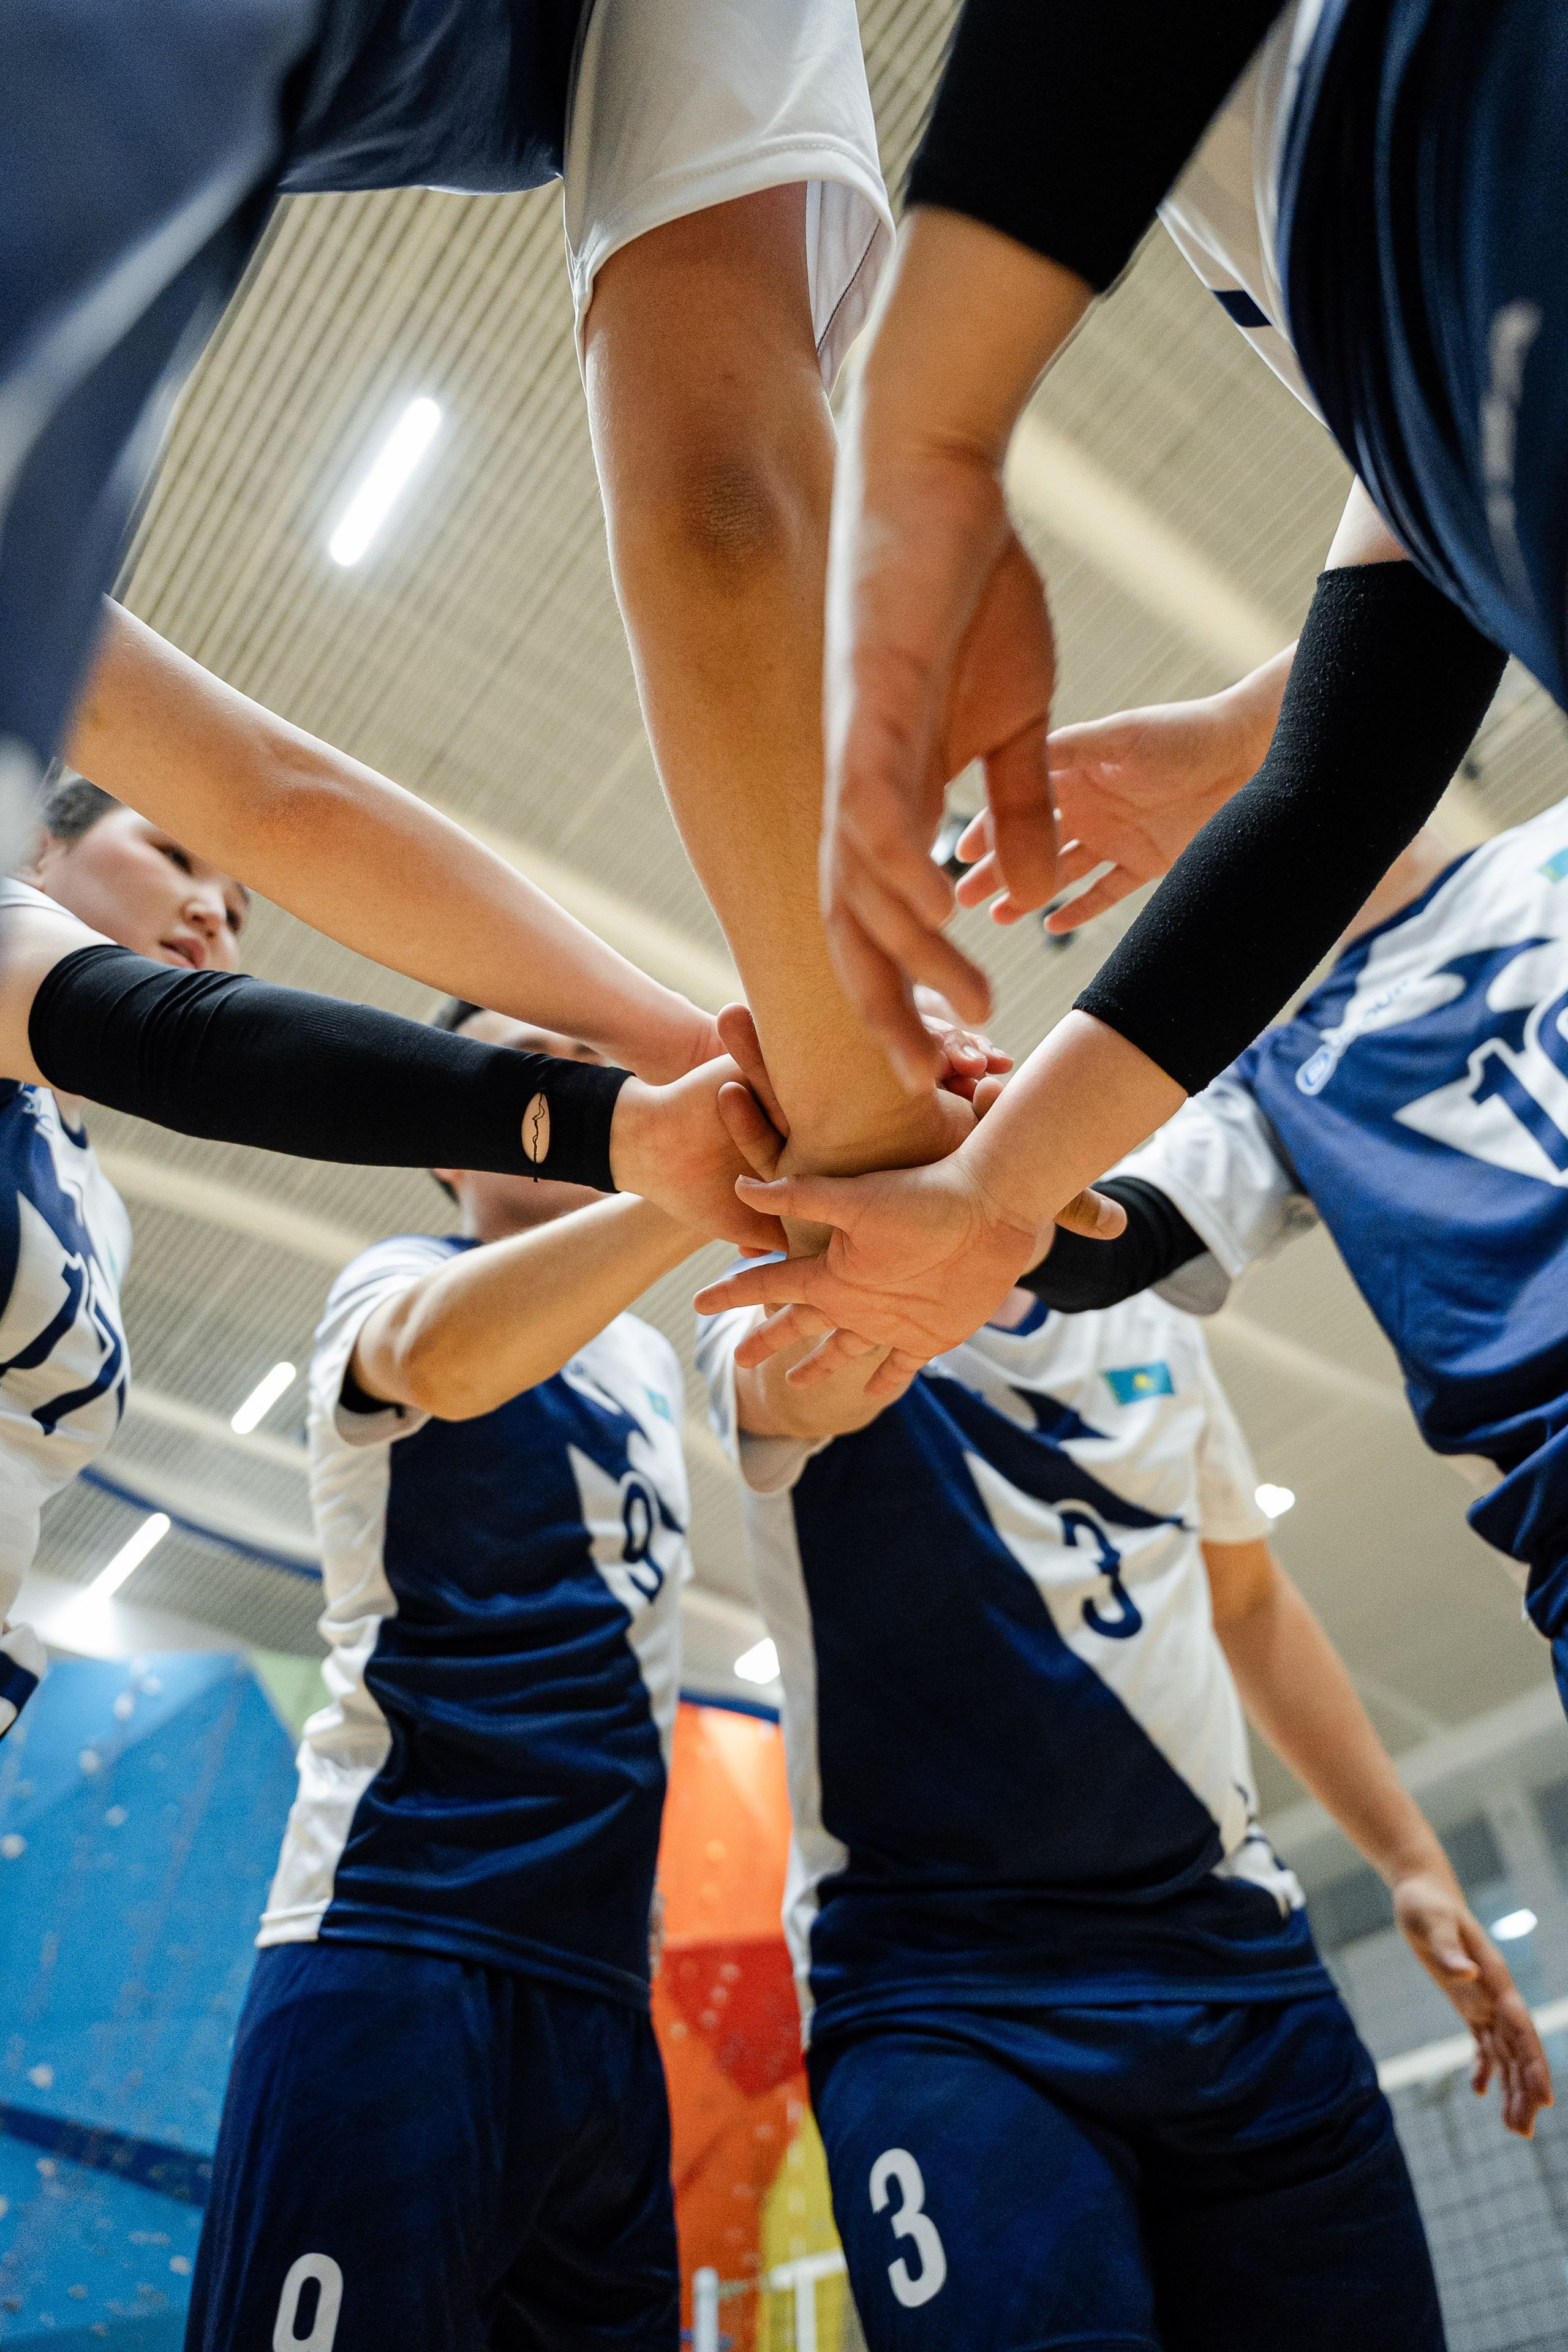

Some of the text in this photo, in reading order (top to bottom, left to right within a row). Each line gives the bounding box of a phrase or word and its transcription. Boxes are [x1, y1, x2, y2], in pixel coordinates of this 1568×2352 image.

[623, 1482, 664, 1605] 9
[1057, 1509, 1143, 1639] 3
[869, 2148, 948, 2308] 3
